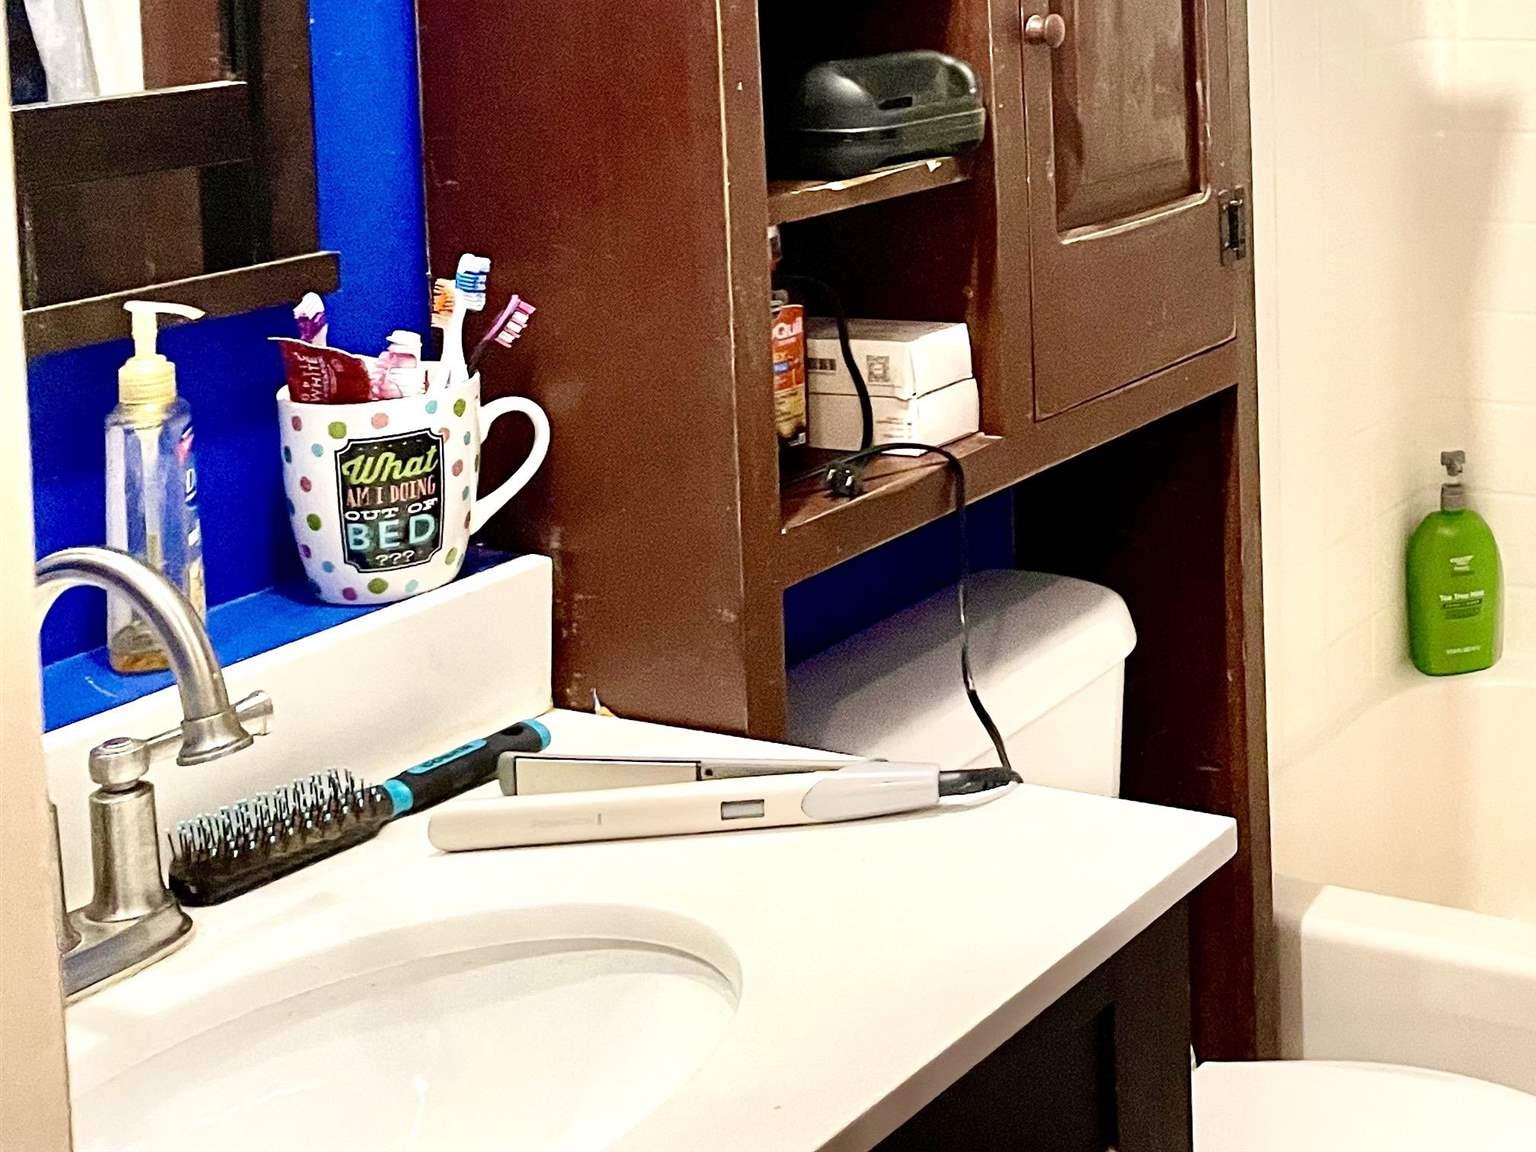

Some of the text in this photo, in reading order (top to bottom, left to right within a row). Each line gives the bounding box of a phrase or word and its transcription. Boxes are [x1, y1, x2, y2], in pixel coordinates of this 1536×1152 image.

[306, 355, 323, 402] WHITE
[341, 445, 438, 485] What
[346, 474, 436, 507] AM I DOING
[344, 497, 438, 521] OUT OF
[346, 513, 435, 550] BED
[375, 550, 415, 566] ???
